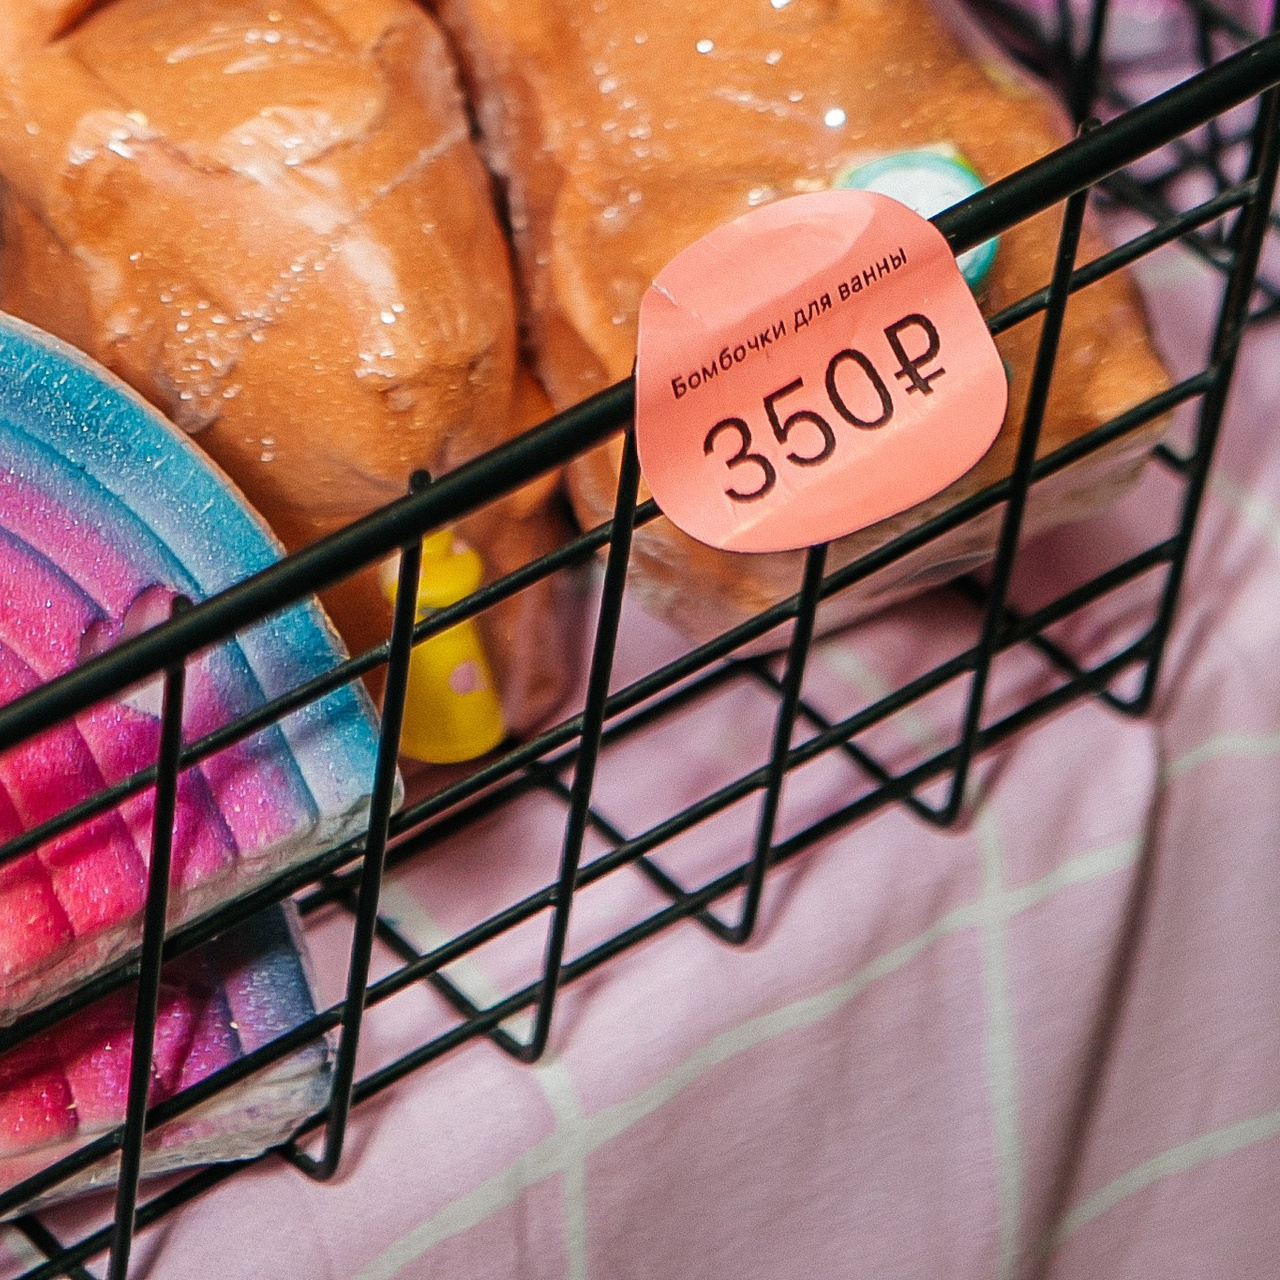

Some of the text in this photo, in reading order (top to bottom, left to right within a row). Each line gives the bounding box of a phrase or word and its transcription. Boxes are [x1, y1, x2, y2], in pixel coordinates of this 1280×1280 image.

[671, 247, 908, 399] Бомбочки для ванны
[703, 312, 947, 504] 350₽
